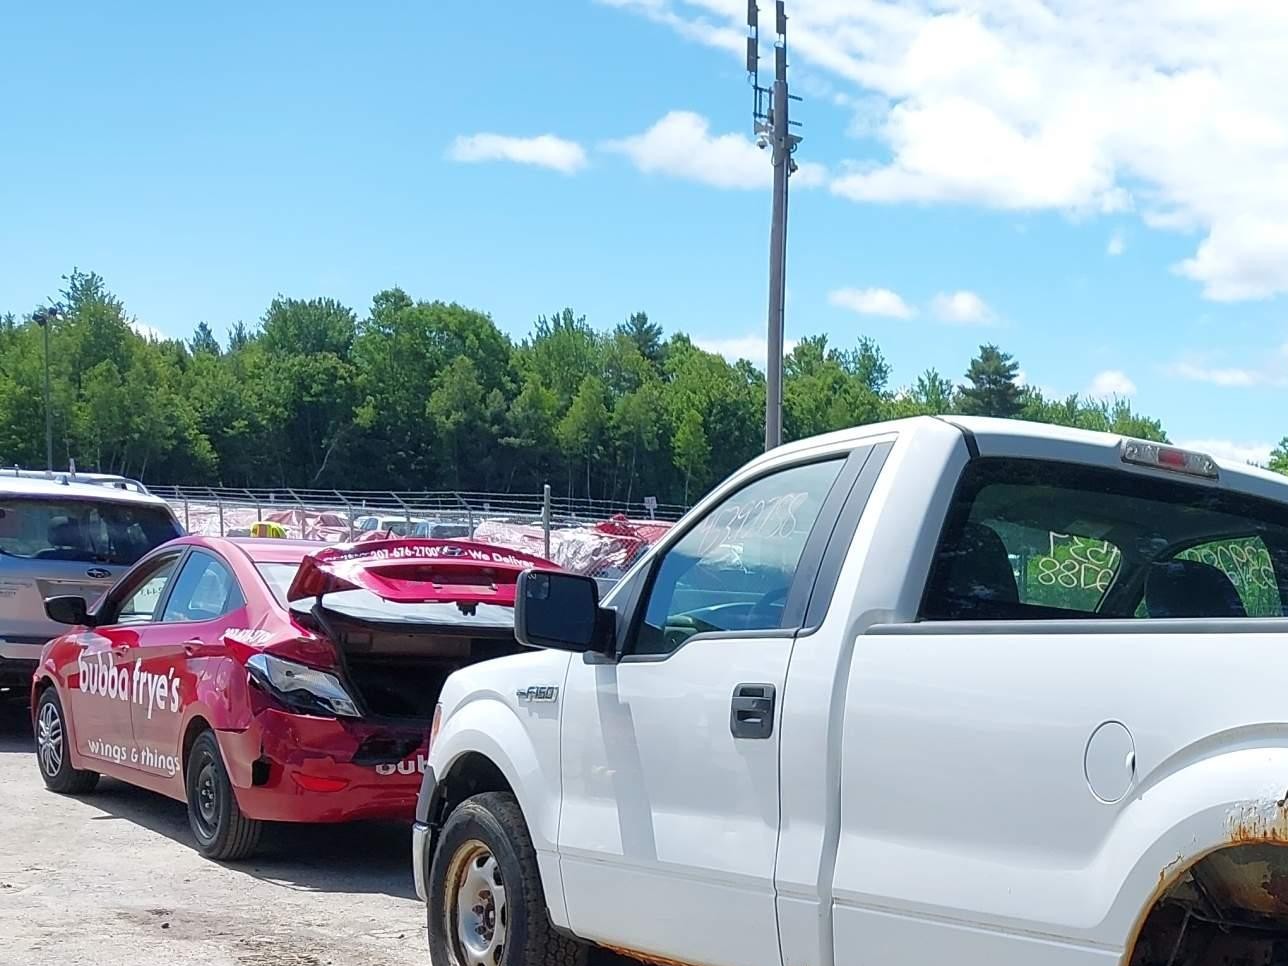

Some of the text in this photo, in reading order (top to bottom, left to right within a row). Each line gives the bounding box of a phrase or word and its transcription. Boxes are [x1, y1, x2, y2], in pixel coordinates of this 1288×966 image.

[469, 549, 491, 561] We
[78, 649, 180, 719] bubba frye's
[88, 738, 127, 763] wings
[141, 749, 181, 776] things
